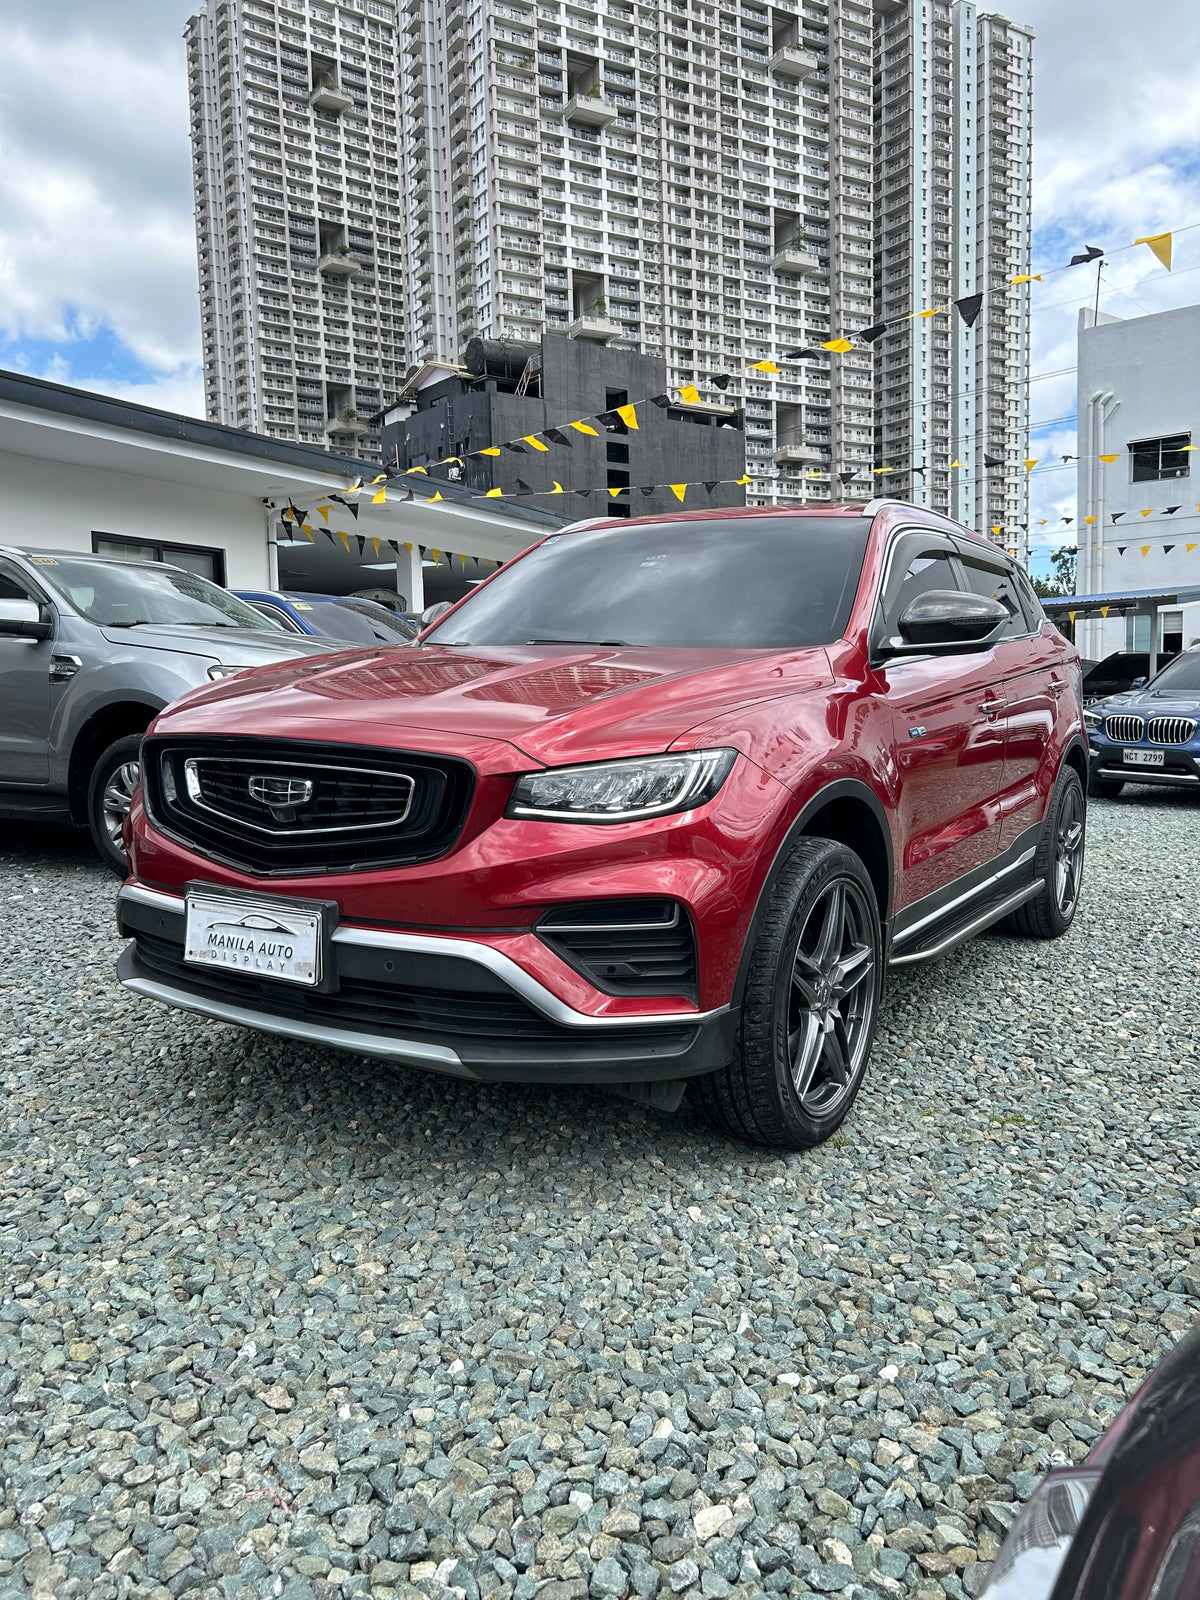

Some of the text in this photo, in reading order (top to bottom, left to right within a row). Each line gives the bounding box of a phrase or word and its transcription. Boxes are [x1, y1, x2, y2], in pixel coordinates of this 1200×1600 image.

[1124, 752, 1163, 762] NCT 2799
[207, 933, 294, 959] MANILA AUTO
[211, 949, 286, 972] DISPLAY
